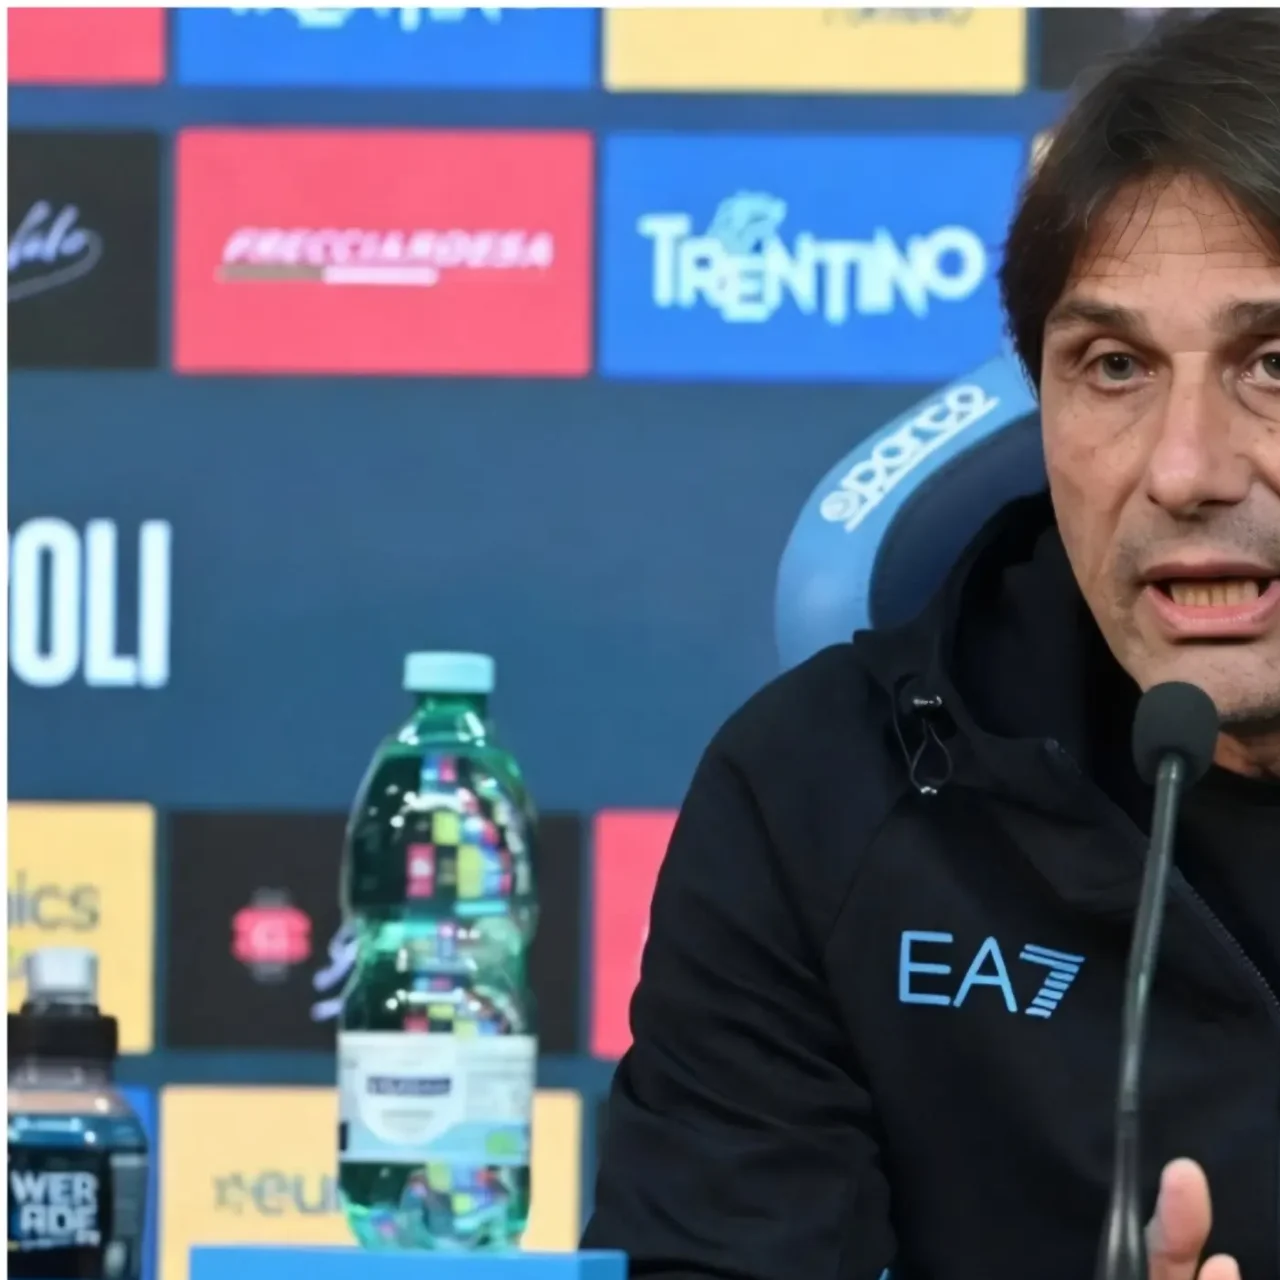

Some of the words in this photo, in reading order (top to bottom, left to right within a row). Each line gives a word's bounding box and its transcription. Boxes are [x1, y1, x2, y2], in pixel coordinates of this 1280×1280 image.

[637, 212, 987, 325] TRENTINO
[8, 516, 172, 690] OLI
[899, 930, 1086, 1019] EA7
